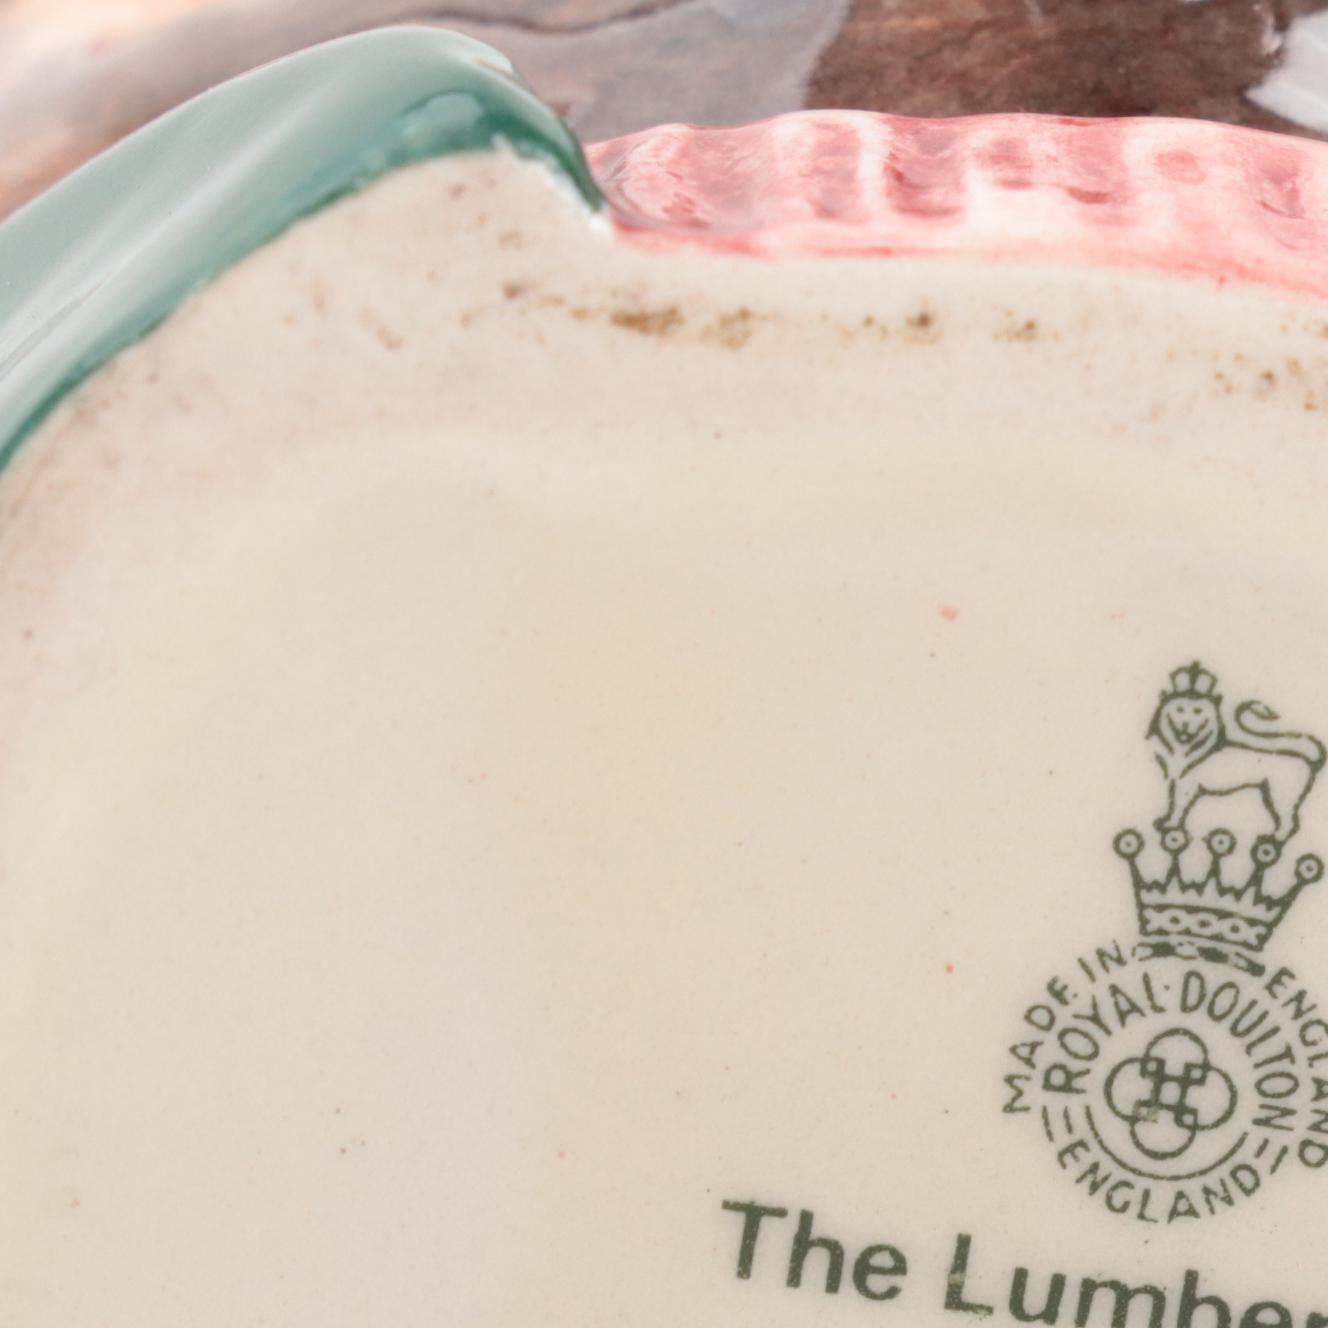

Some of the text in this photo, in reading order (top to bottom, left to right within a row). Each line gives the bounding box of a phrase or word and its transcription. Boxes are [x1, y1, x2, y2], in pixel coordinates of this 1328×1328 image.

[1002, 975, 1073, 1114] MADE
[1077, 940, 1127, 982] IN
[1042, 970, 1300, 1132] ROYAL DOULTON
[1056, 1138, 1261, 1224] ENGLAND
[721, 1199, 909, 1302] The
